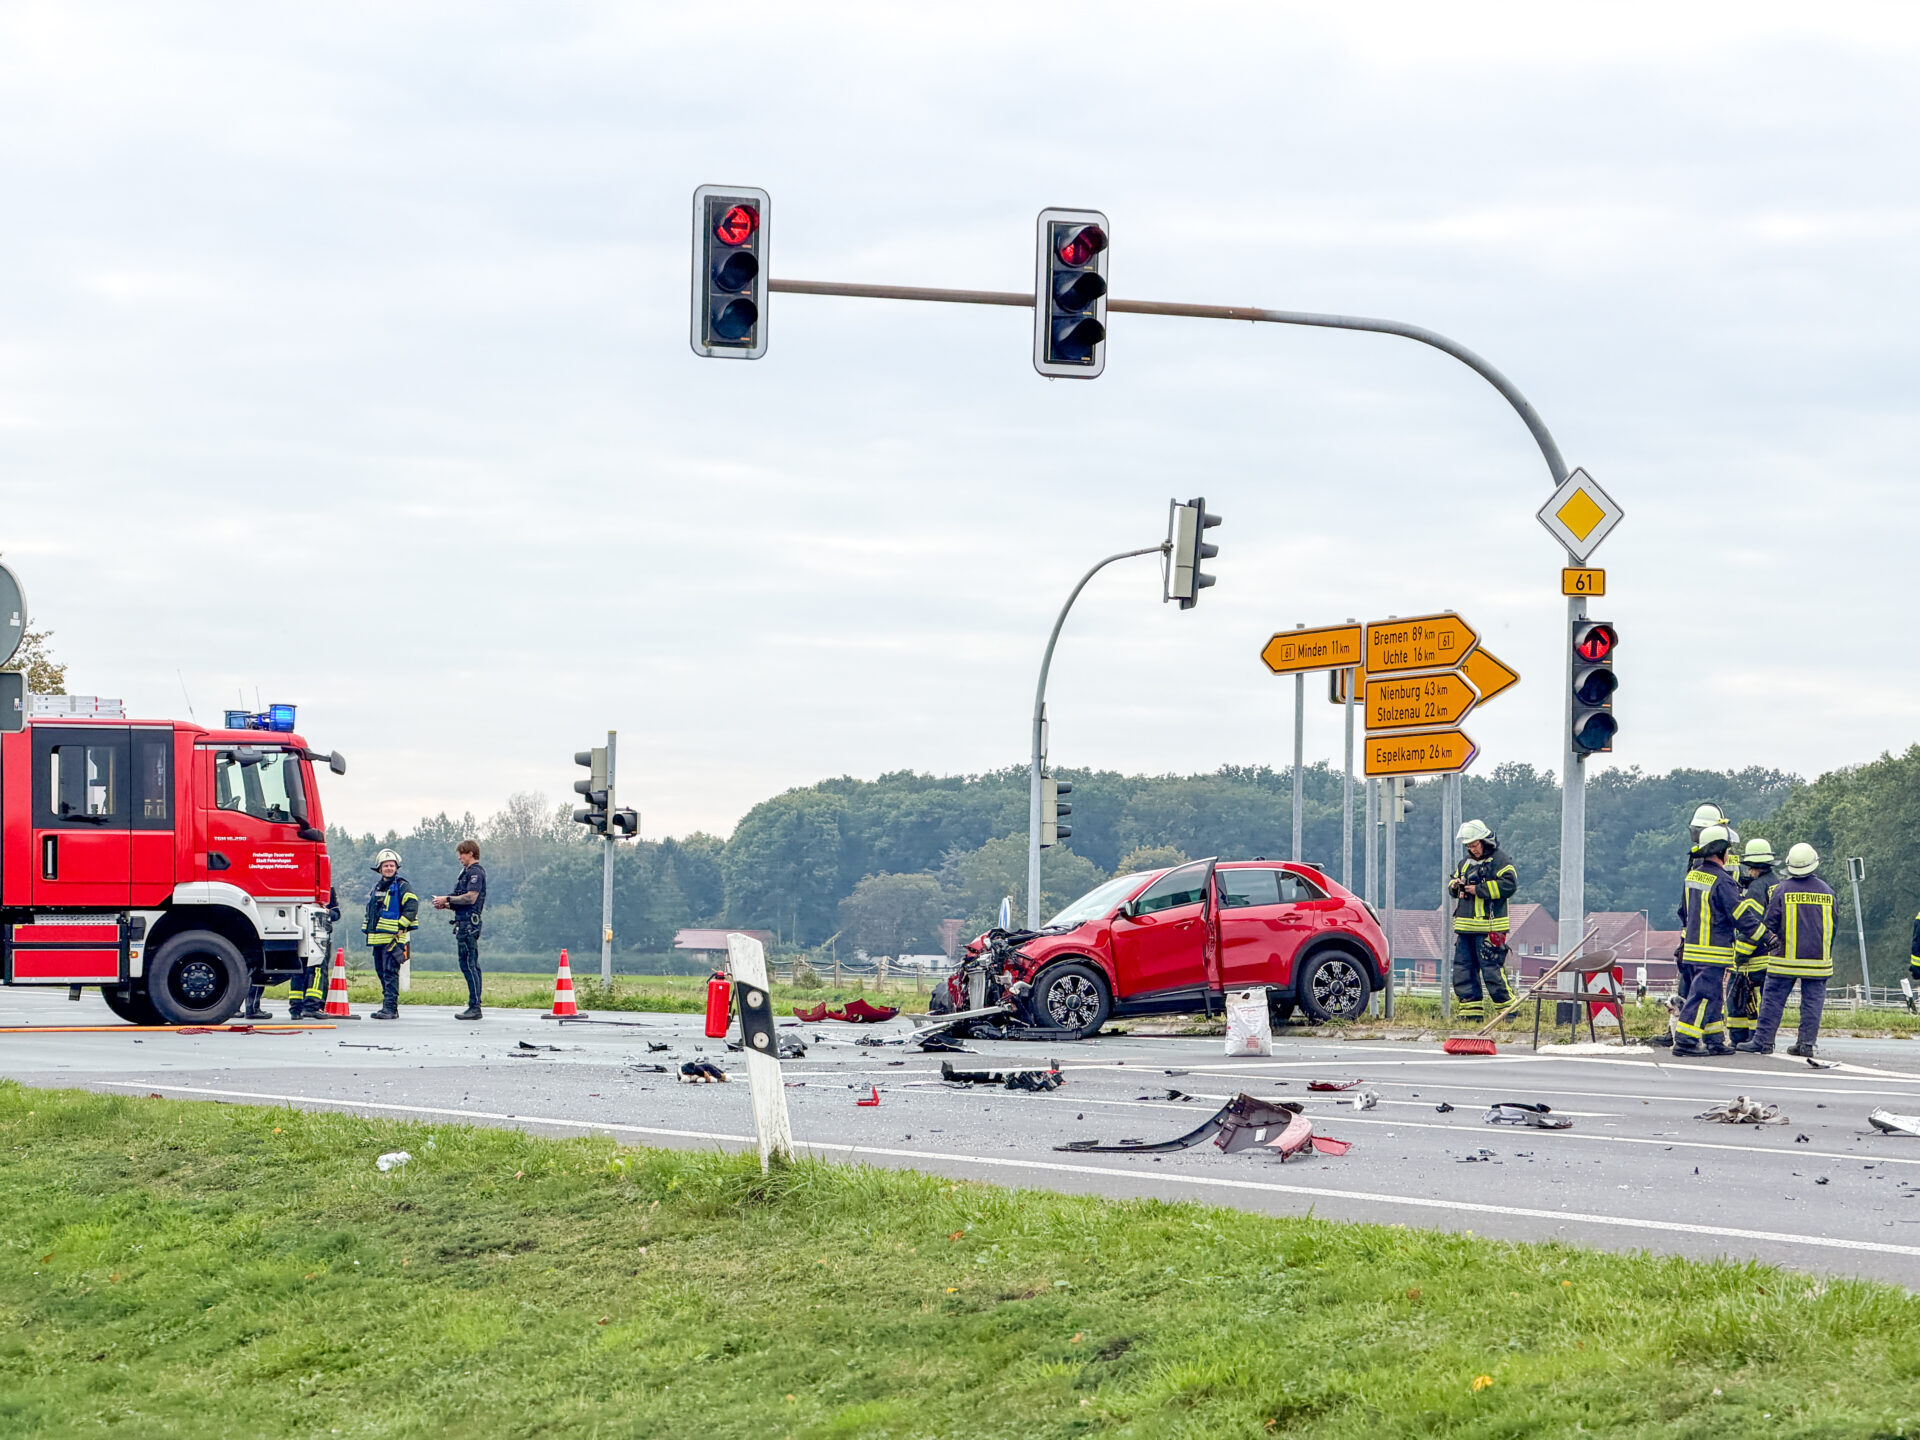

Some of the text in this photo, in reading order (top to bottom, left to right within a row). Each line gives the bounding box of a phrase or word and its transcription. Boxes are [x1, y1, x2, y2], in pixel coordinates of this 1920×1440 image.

[1575, 573, 1592, 591] 61
[1374, 626, 1435, 646] Bremen 89 km
[1442, 635, 1450, 647] 61
[1285, 647, 1292, 658] 61
[1298, 642, 1327, 658] Minden
[1383, 647, 1435, 665] Uchte 16 km
[1380, 681, 1448, 702] Nienburg 43 km
[1377, 702, 1448, 722] Stolzenau 22 km
[1376, 744, 1452, 766] Espelkamp 26 km
[1786, 893, 1831, 904] FEUERWEHR
